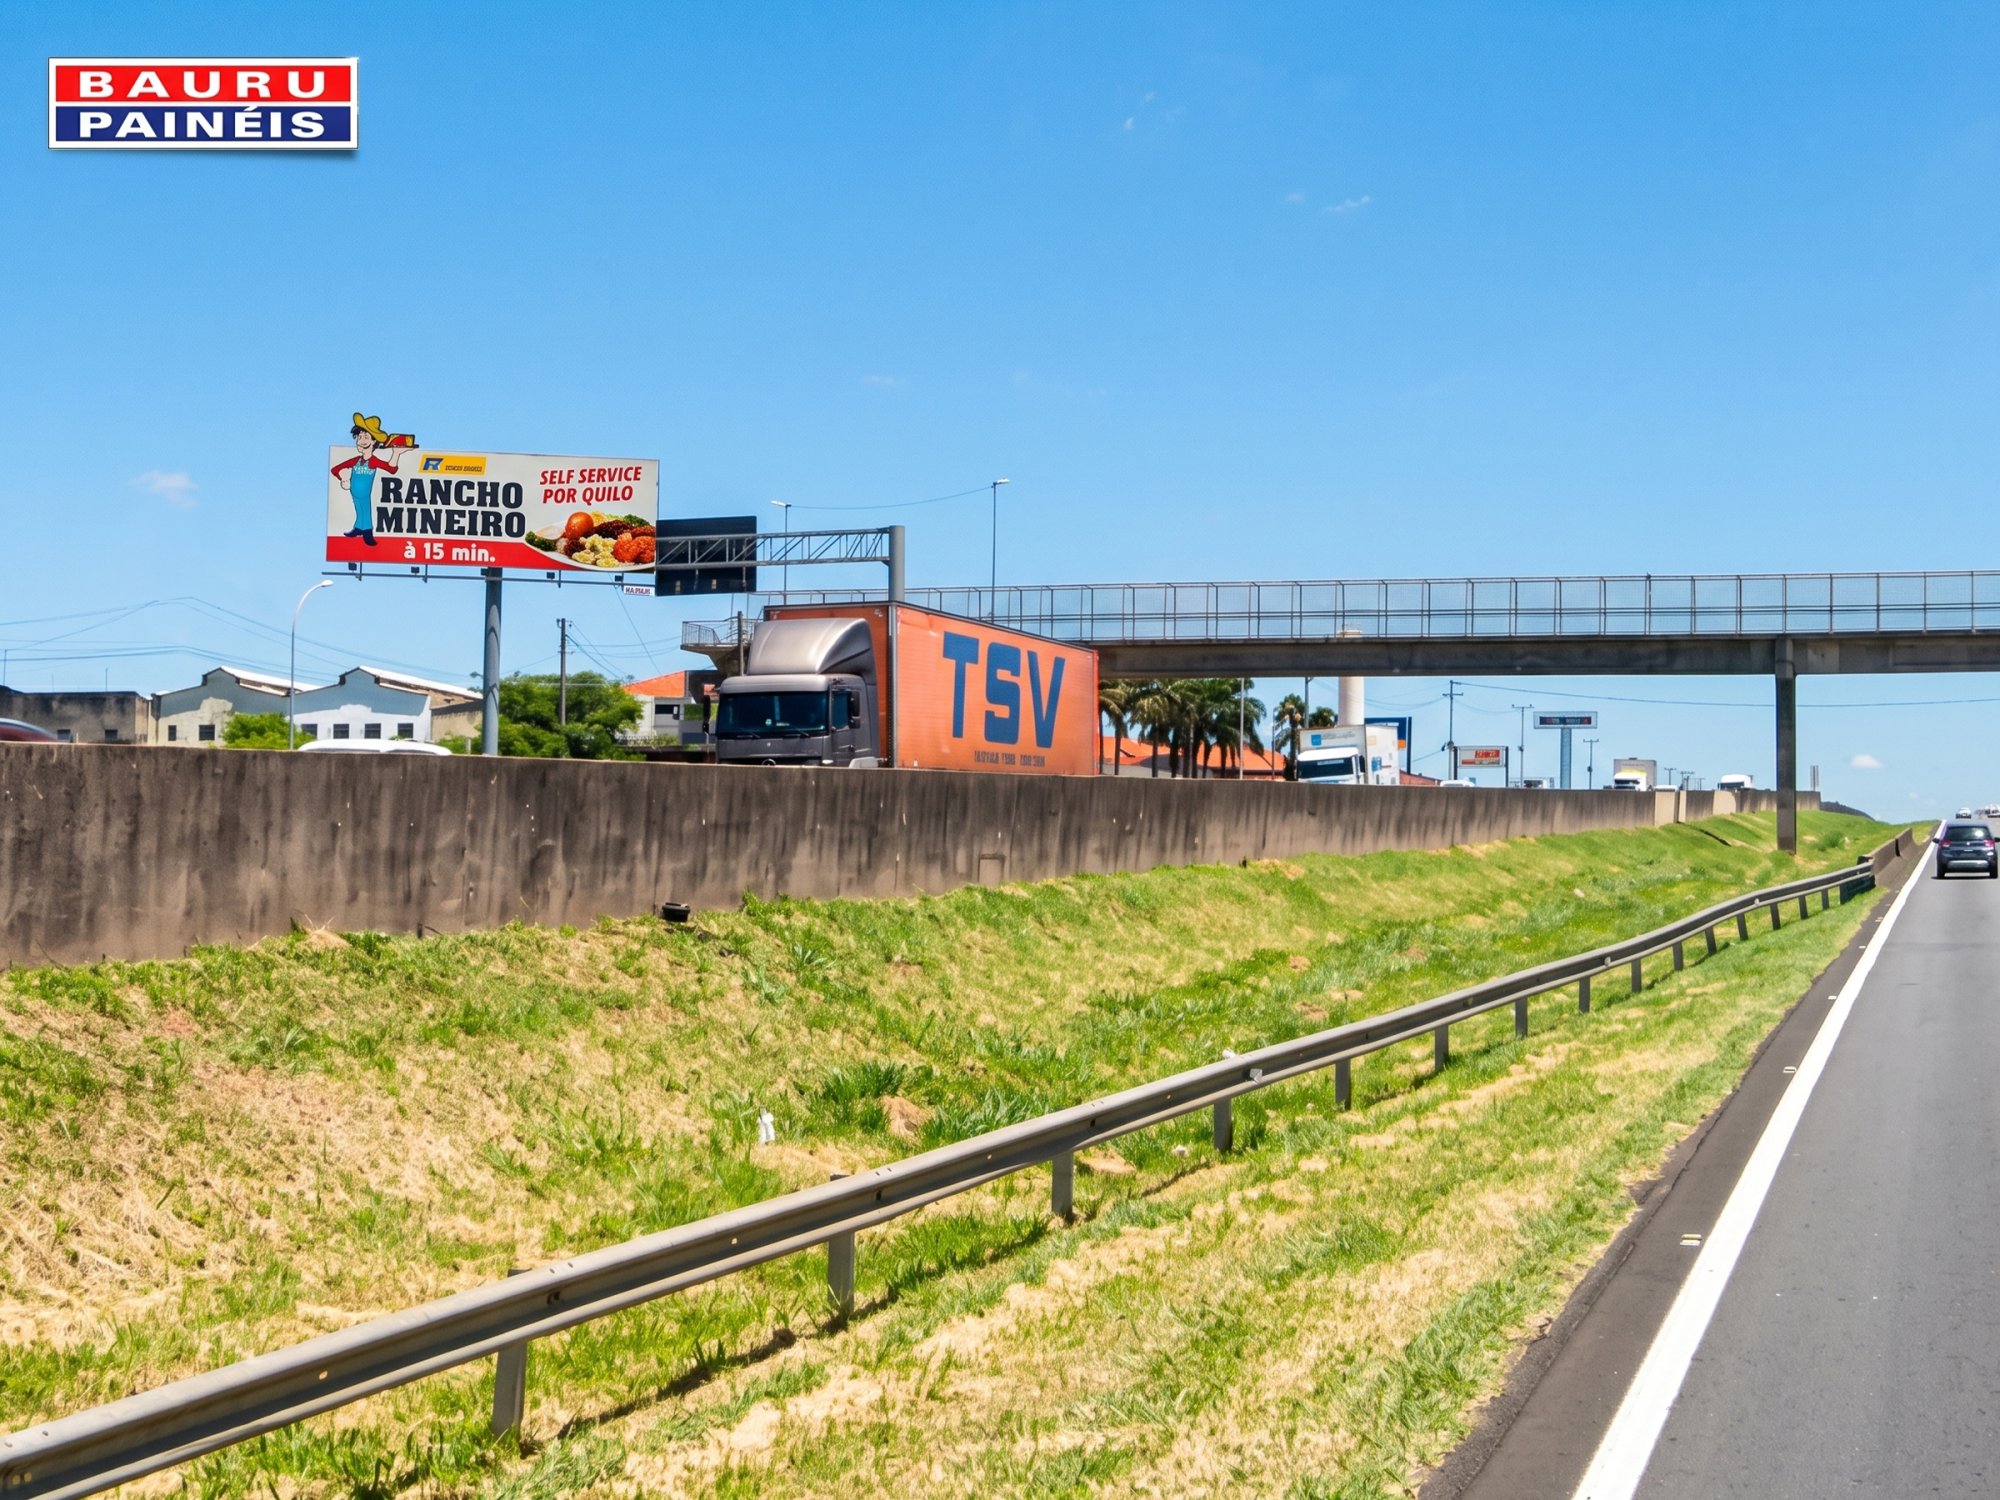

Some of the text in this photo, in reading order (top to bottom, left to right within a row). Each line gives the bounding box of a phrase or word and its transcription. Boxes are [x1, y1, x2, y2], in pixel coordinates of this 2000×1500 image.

[540, 466, 642, 485] SELF SERVICE
[380, 477, 523, 509] RANCHO
[543, 485, 633, 506] POR QUILO
[376, 506, 526, 538] MINEIRO
[403, 541, 496, 562] à 15 min.
[943, 631, 1065, 748] TSV
